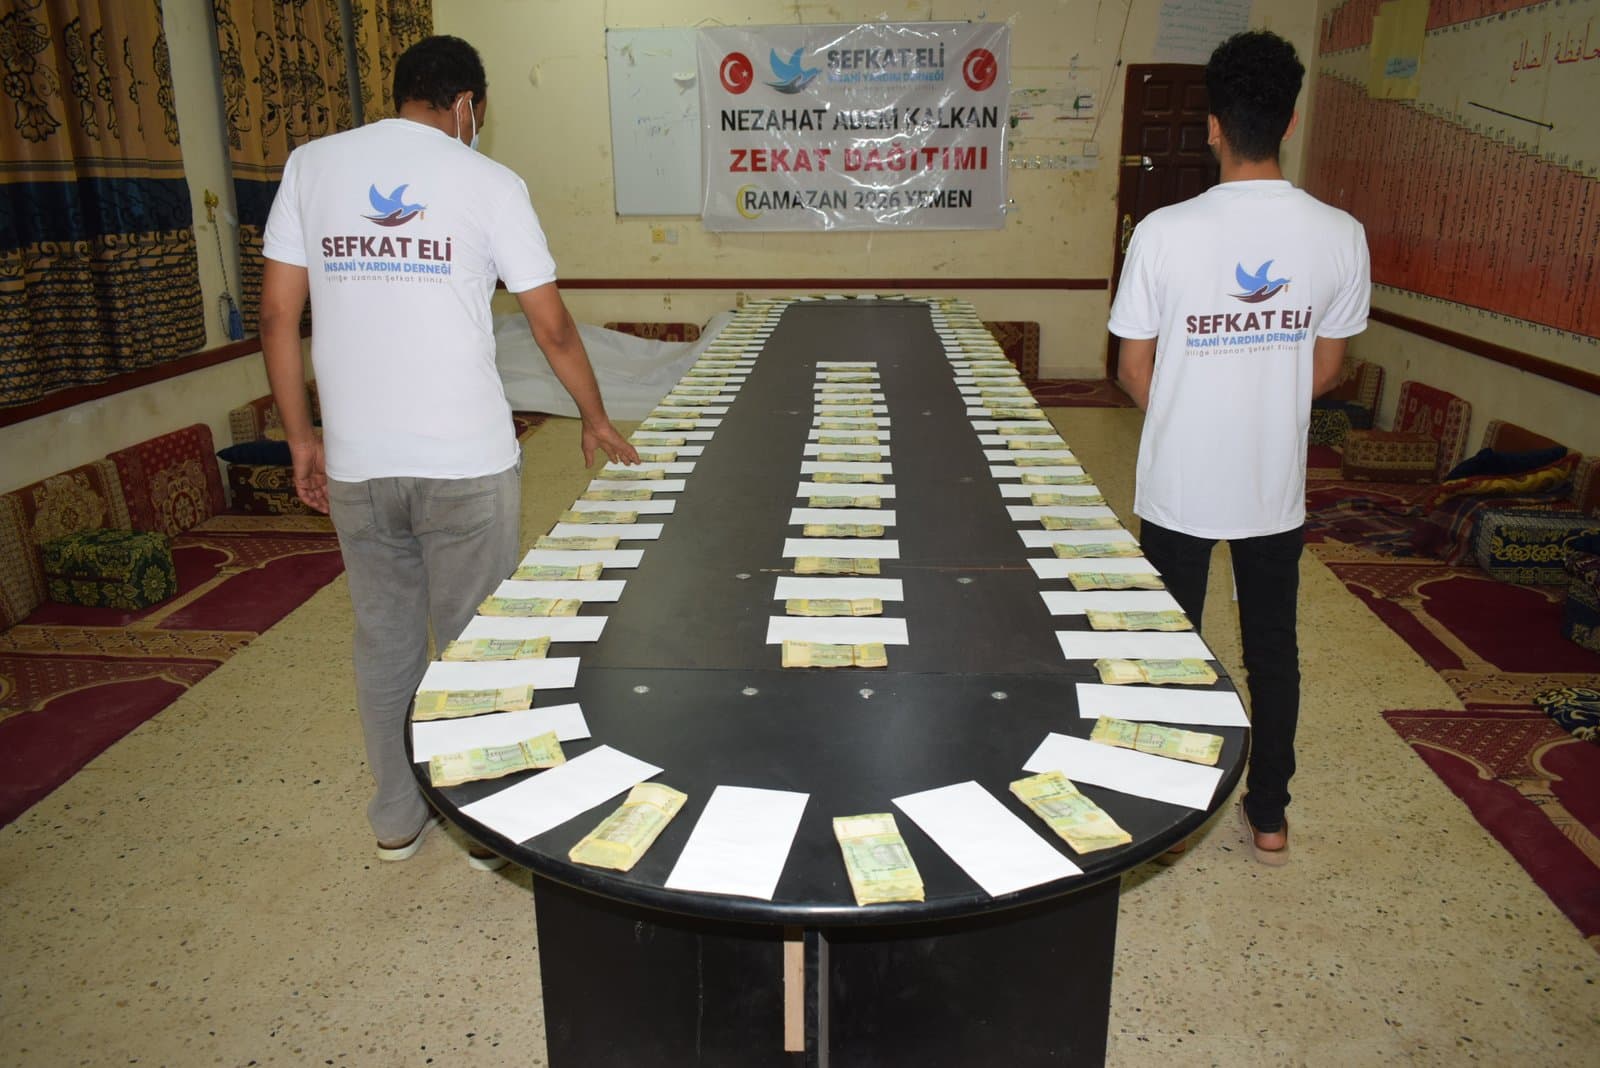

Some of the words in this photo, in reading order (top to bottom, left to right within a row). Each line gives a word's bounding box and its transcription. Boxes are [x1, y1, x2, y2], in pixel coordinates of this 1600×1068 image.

[1554, 17, 1600, 65] حافظة
[721, 109, 827, 131] NEZAHAT
[904, 106, 998, 130] KALKAN
[729, 148, 831, 173] ZEKAT
[844, 142, 988, 172] DAĞITIMI
[744, 190, 847, 210] RAMAZAN
[903, 190, 972, 209] YEMEN
[418, 236, 453, 262] ELİ
[358, 261, 401, 273] YARDIM
[1281, 306, 1313, 330] ELİ
[1222, 333, 1264, 346] YARDIM
